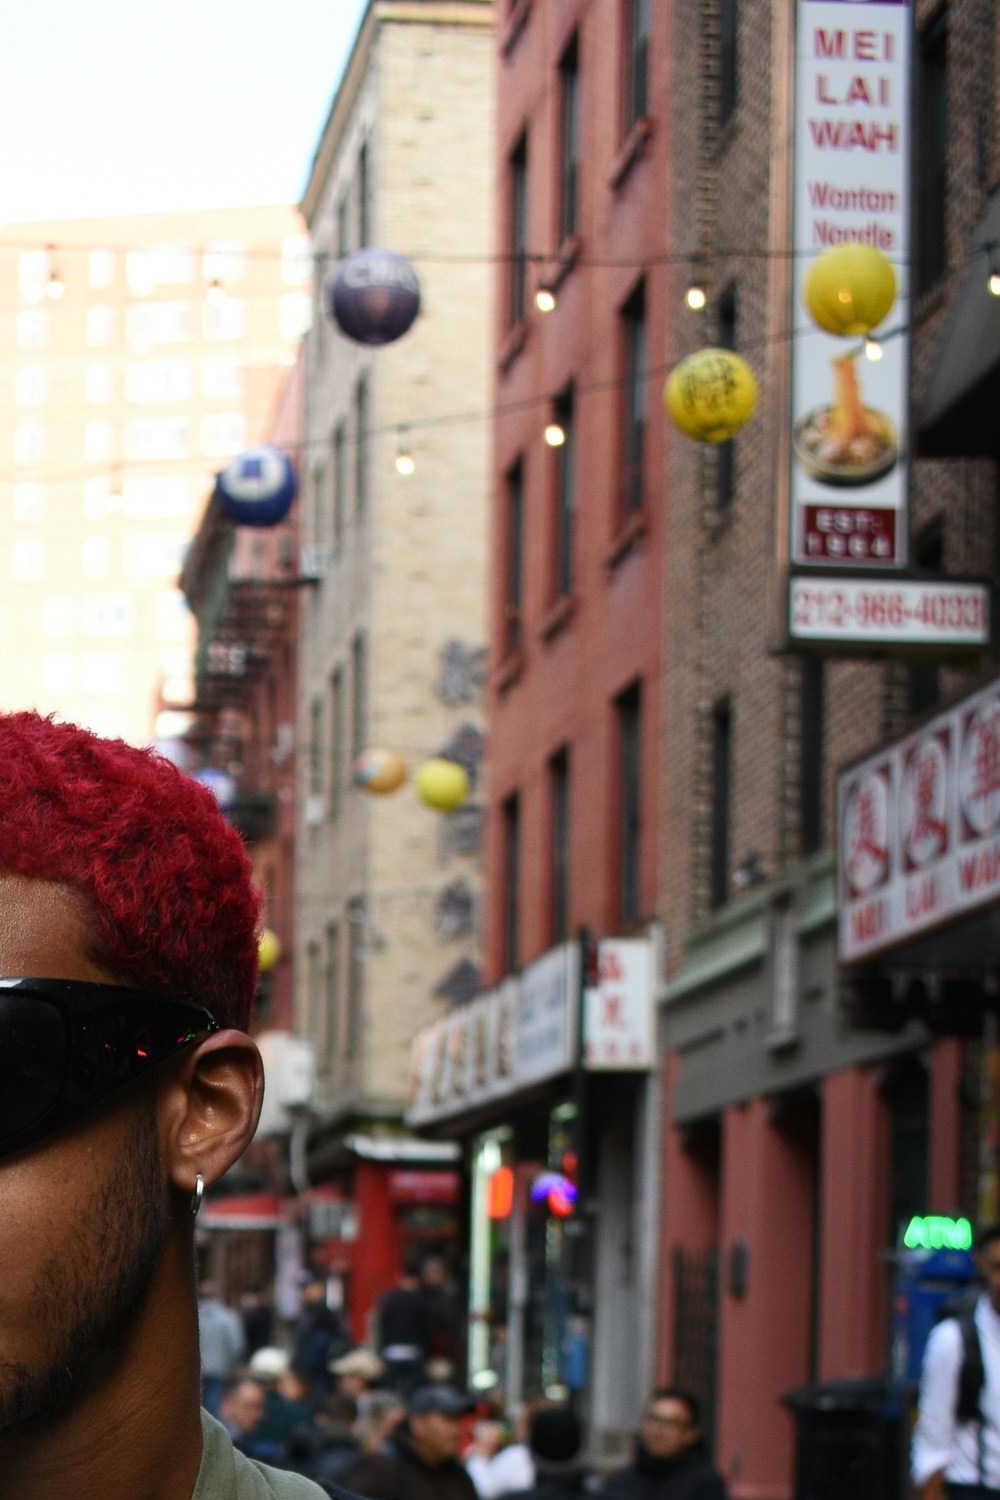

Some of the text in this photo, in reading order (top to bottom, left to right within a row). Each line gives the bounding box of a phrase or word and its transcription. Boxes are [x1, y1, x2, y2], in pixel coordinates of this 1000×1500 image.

[815, 28, 895, 61] MEI
[815, 73, 889, 106] LAI
[808, 120, 897, 152] WAH
[809, 182, 894, 212] Wonton
[903, 1215, 972, 1251] ATM
